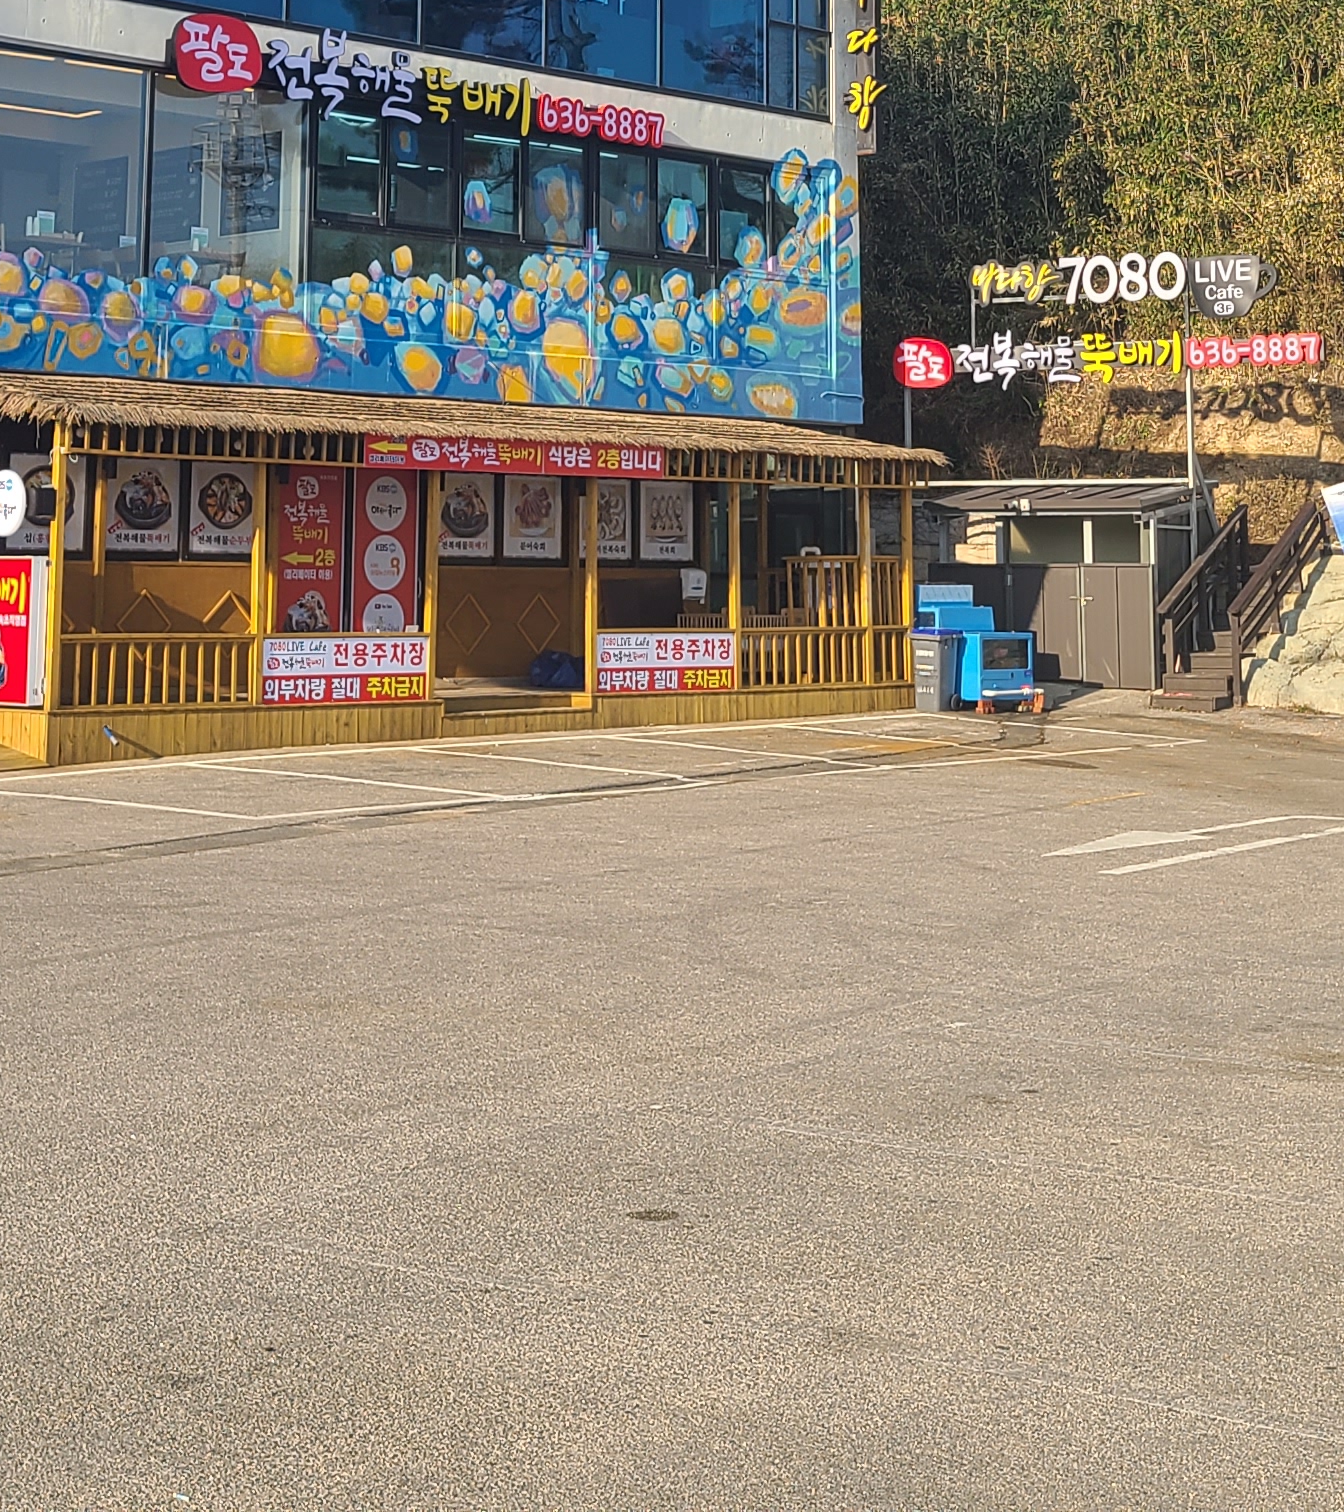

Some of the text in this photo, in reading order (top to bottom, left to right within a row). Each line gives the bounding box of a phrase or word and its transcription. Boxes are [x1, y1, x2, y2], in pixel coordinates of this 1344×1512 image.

[181, 19, 254, 83] 팔도
[539, 94, 665, 148] 636-8887
[972, 251, 1186, 305] 바다향 7080
[1194, 258, 1252, 284] LIVE
[1204, 284, 1244, 301] Cafe
[1216, 303, 1234, 315] 3F
[897, 342, 947, 381] 팔도
[1188, 333, 1320, 366] 636-8887
[414, 441, 438, 458] 팔도
[548, 445, 592, 468] 식당은
[596, 449, 662, 472] 2층입니다
[315, 549, 336, 567] 2층
[333, 642, 425, 667] 전용주차장
[655, 638, 732, 661] 전용주차장
[264, 676, 424, 702] 외부차량 절대 주차금지
[598, 669, 732, 691] 외부차량 절대 주차금지
